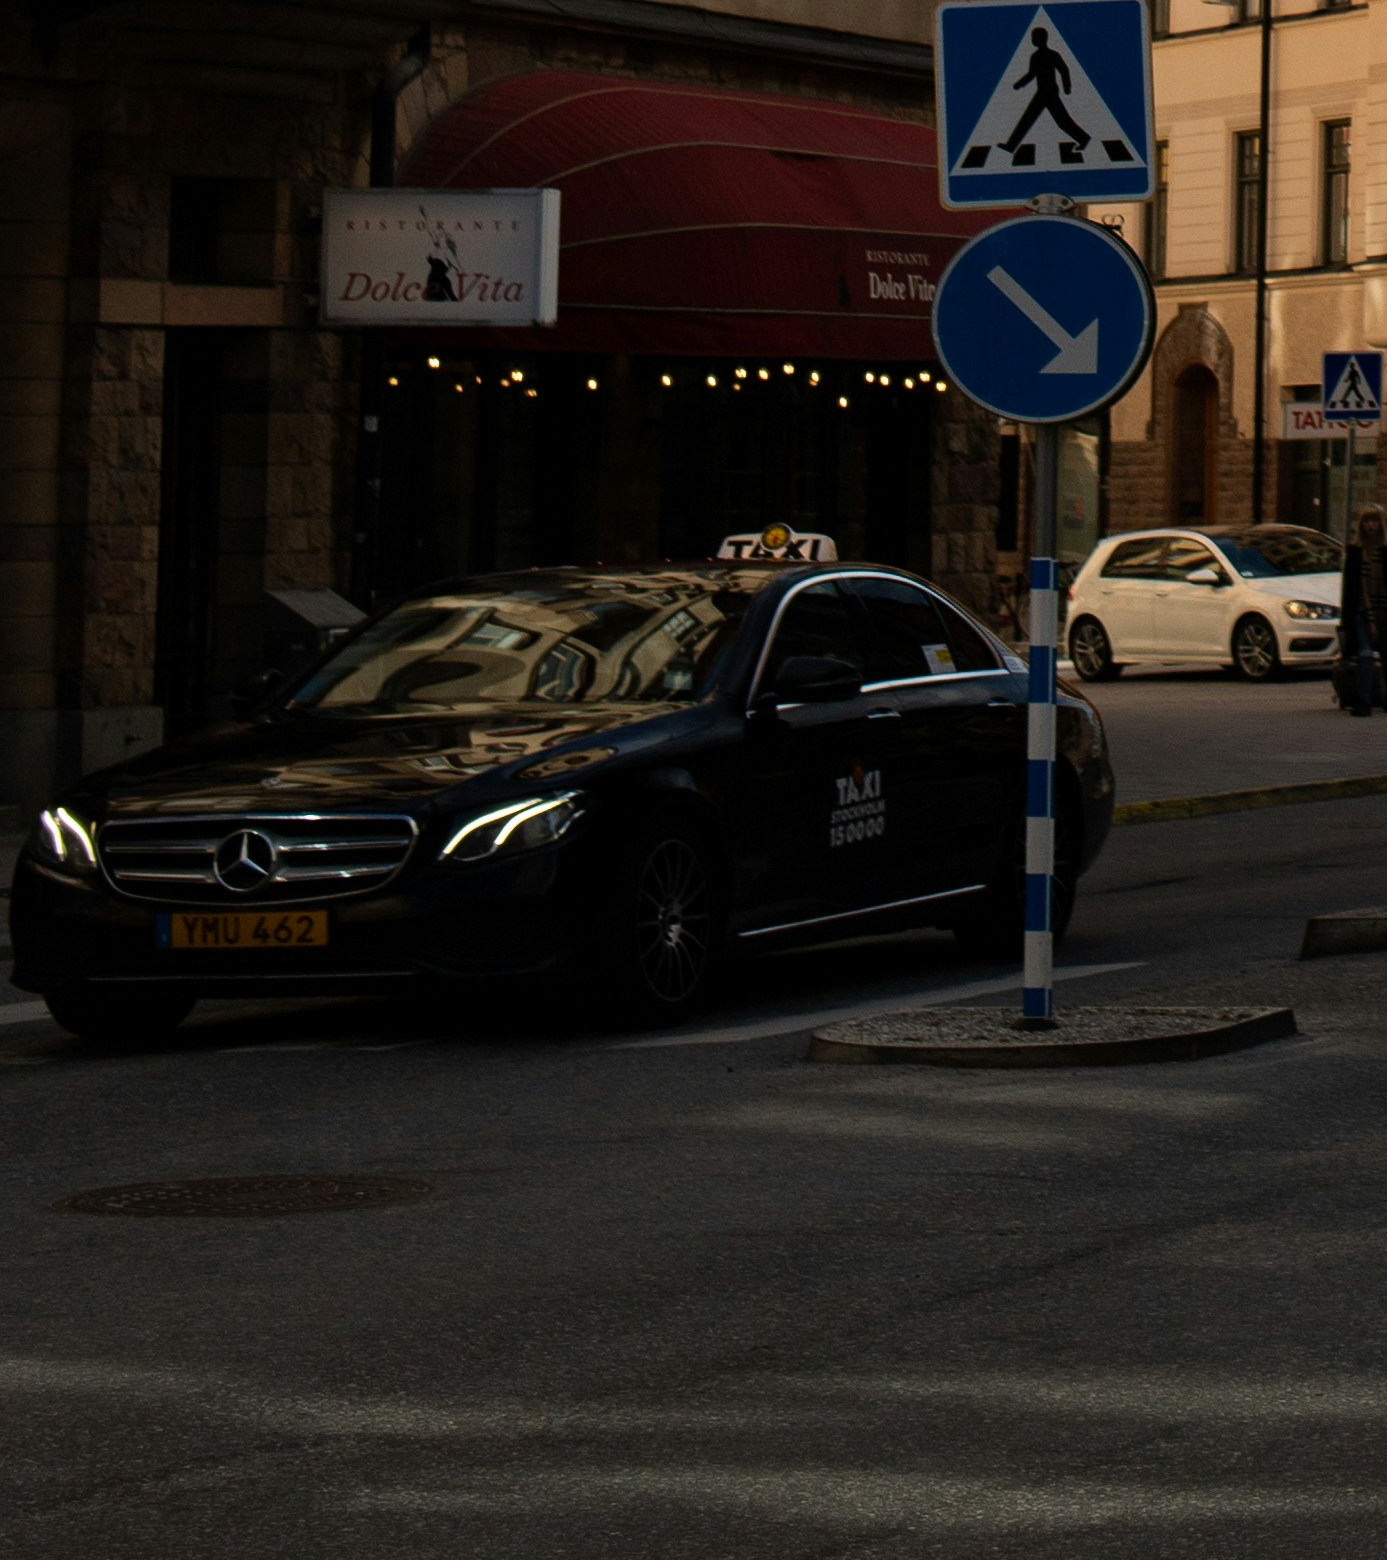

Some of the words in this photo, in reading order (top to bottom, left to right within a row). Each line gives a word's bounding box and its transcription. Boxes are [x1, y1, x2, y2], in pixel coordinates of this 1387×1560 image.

[346, 221, 521, 232] RISTORANTE
[865, 249, 931, 267] RISTORANTE
[339, 272, 443, 302] Dolce
[454, 272, 525, 303] Vita
[867, 271, 906, 301] Dolce
[727, 539, 820, 560] TAXI
[835, 769, 882, 807] TAXI
[182, 916, 241, 945] YMU
[251, 915, 315, 944] 462
